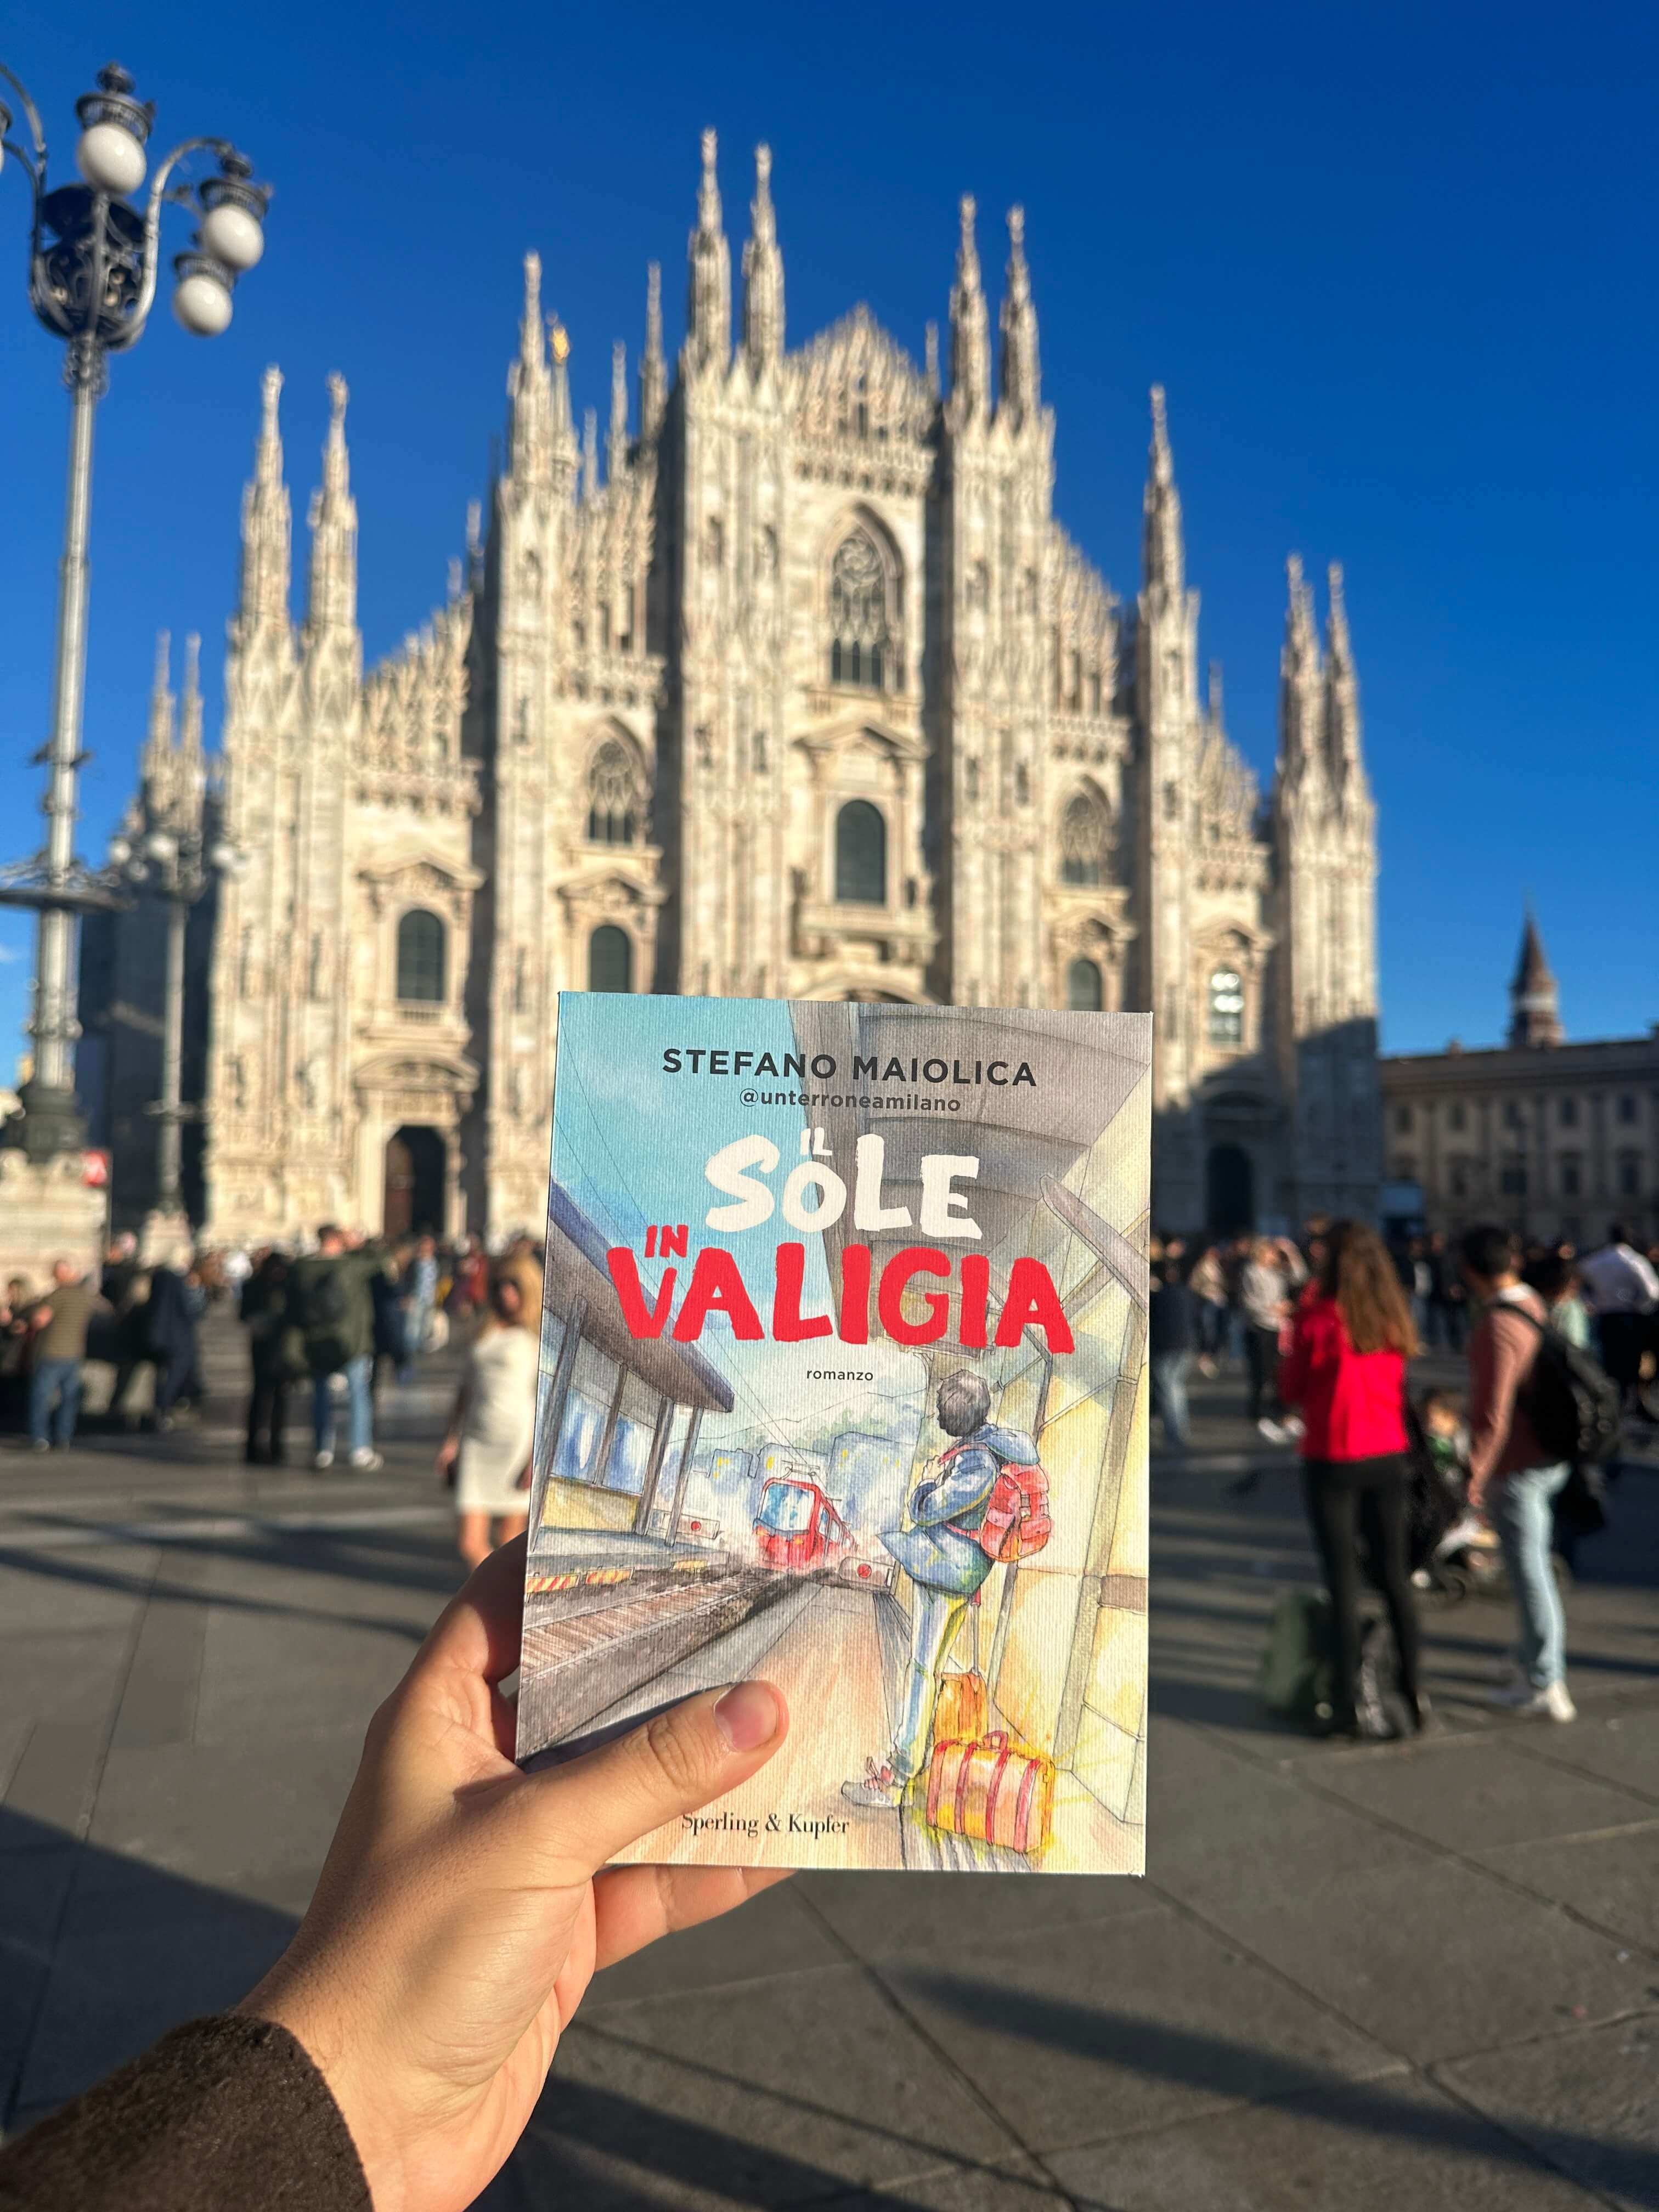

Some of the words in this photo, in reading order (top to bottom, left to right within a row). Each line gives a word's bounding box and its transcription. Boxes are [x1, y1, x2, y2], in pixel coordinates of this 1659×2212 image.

[663, 1048, 837, 1079] STEFANO
[853, 1056, 1037, 1087] MAIOLICA
[740, 1088, 961, 1111] @unterroneamilano
[800, 1127, 832, 1156] IL
[705, 1134, 983, 1239] SOLE
[645, 1224, 689, 1257] IN
[607, 1243, 1075, 1353] VALIGIA
[806, 1370, 873, 1381] romanzo
[682, 1812, 759, 1838] Sperling
[765, 1813, 782, 1832] &
[788, 1813, 849, 1839] Kupfer
